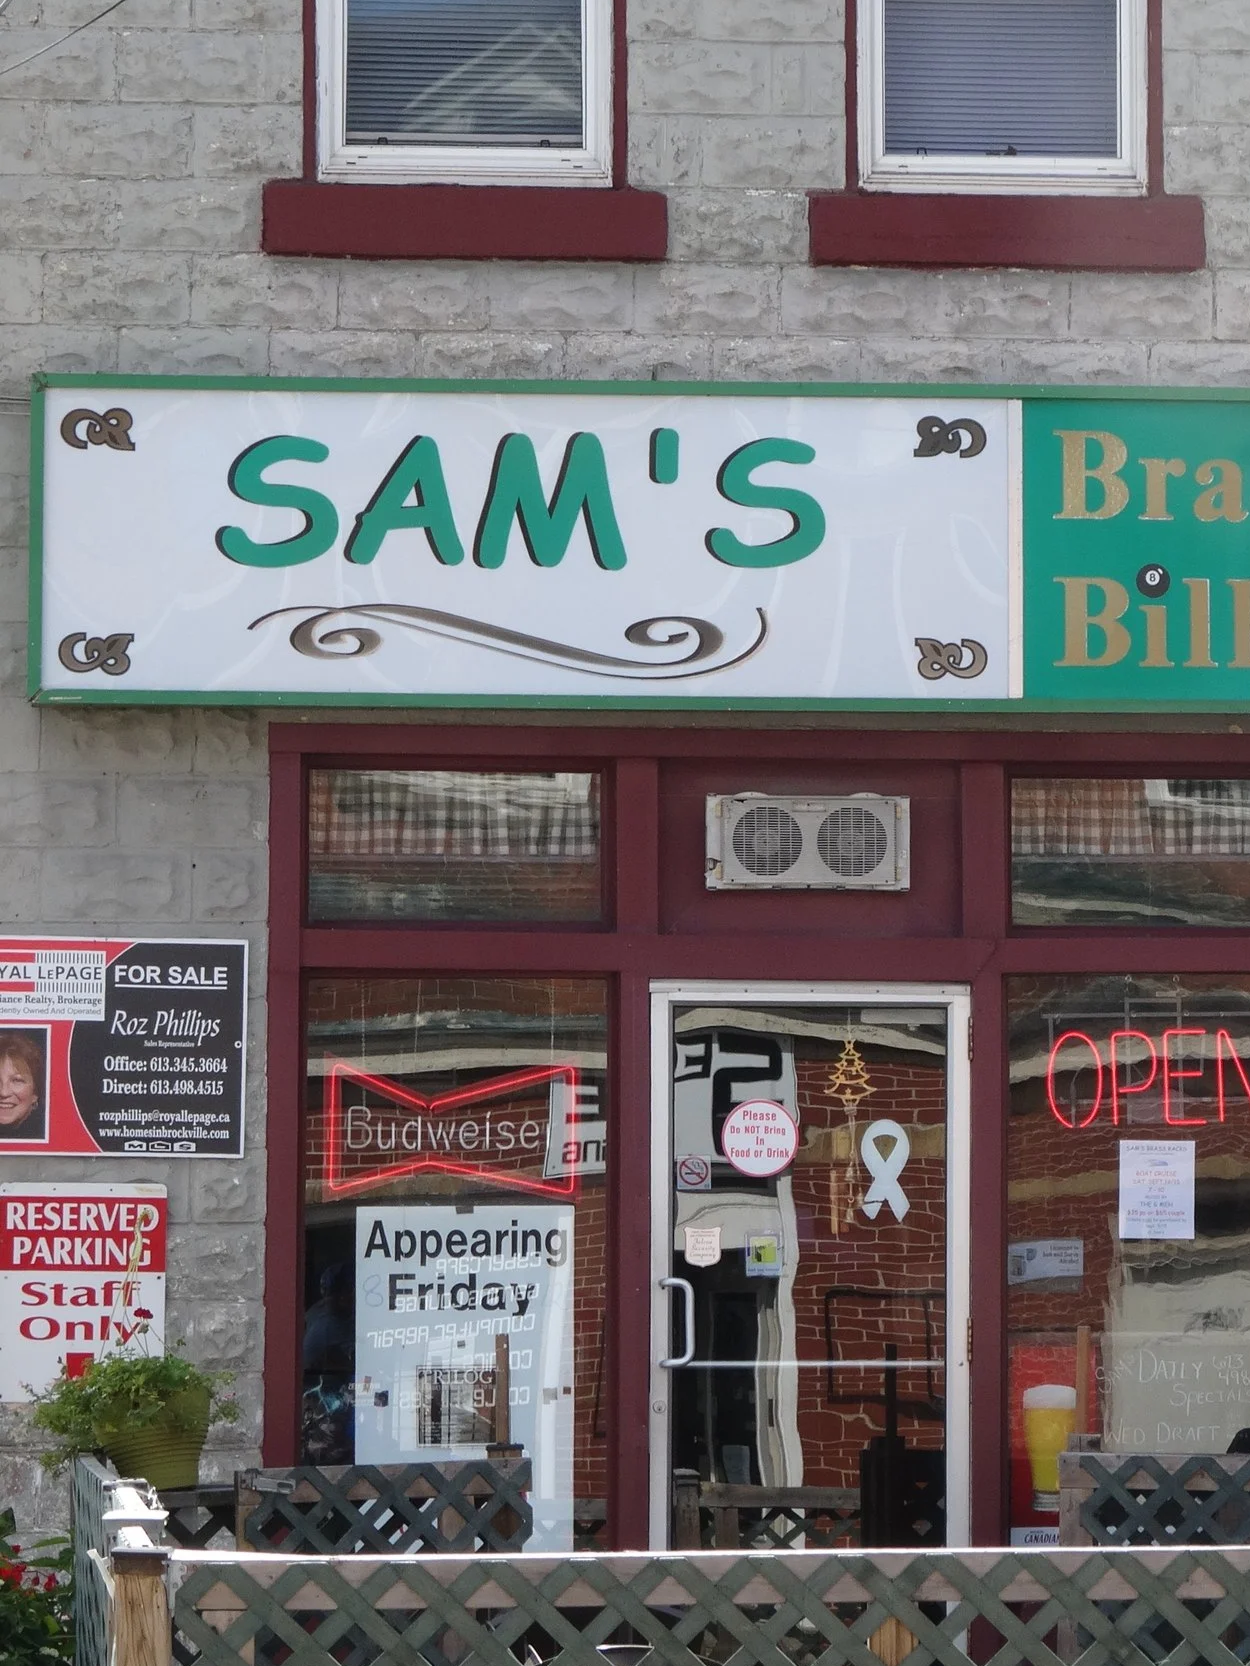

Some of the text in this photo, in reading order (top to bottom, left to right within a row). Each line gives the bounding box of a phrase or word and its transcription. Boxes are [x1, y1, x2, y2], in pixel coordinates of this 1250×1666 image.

[215, 427, 826, 571] SAM'S
[114, 964, 228, 985] FOR SALE
[24, 994, 55, 1006] Realty,
[57, 995, 102, 1007] Brokerage
[50, 1007, 65, 1015] And
[110, 1008, 221, 1047] Roz Phillips
[103, 1056, 228, 1073] Office: 613.345.3664
[102, 1078, 224, 1095] Direct: 613.498.4515
[99, 1109, 231, 1126] rozphillips@royallepage.ca
[743, 1110, 777, 1121] Please
[99, 1126, 230, 1139] www.homesinbrockville.com
[730, 1125, 786, 1136] Do NOT Bring
[755, 1136, 765, 1146] In
[730, 1147, 790, 1158] Food or Drink
[6, 1202, 160, 1232] RESERVED
[12, 1236, 152, 1267] PARKING
[363, 1219, 568, 1268] Appearing
[21, 1280, 142, 1307] Staff
[388, 1273, 536, 1318] Friday
[19, 1316, 144, 1345] Only
[417, 1368, 500, 1385] TRILOG
